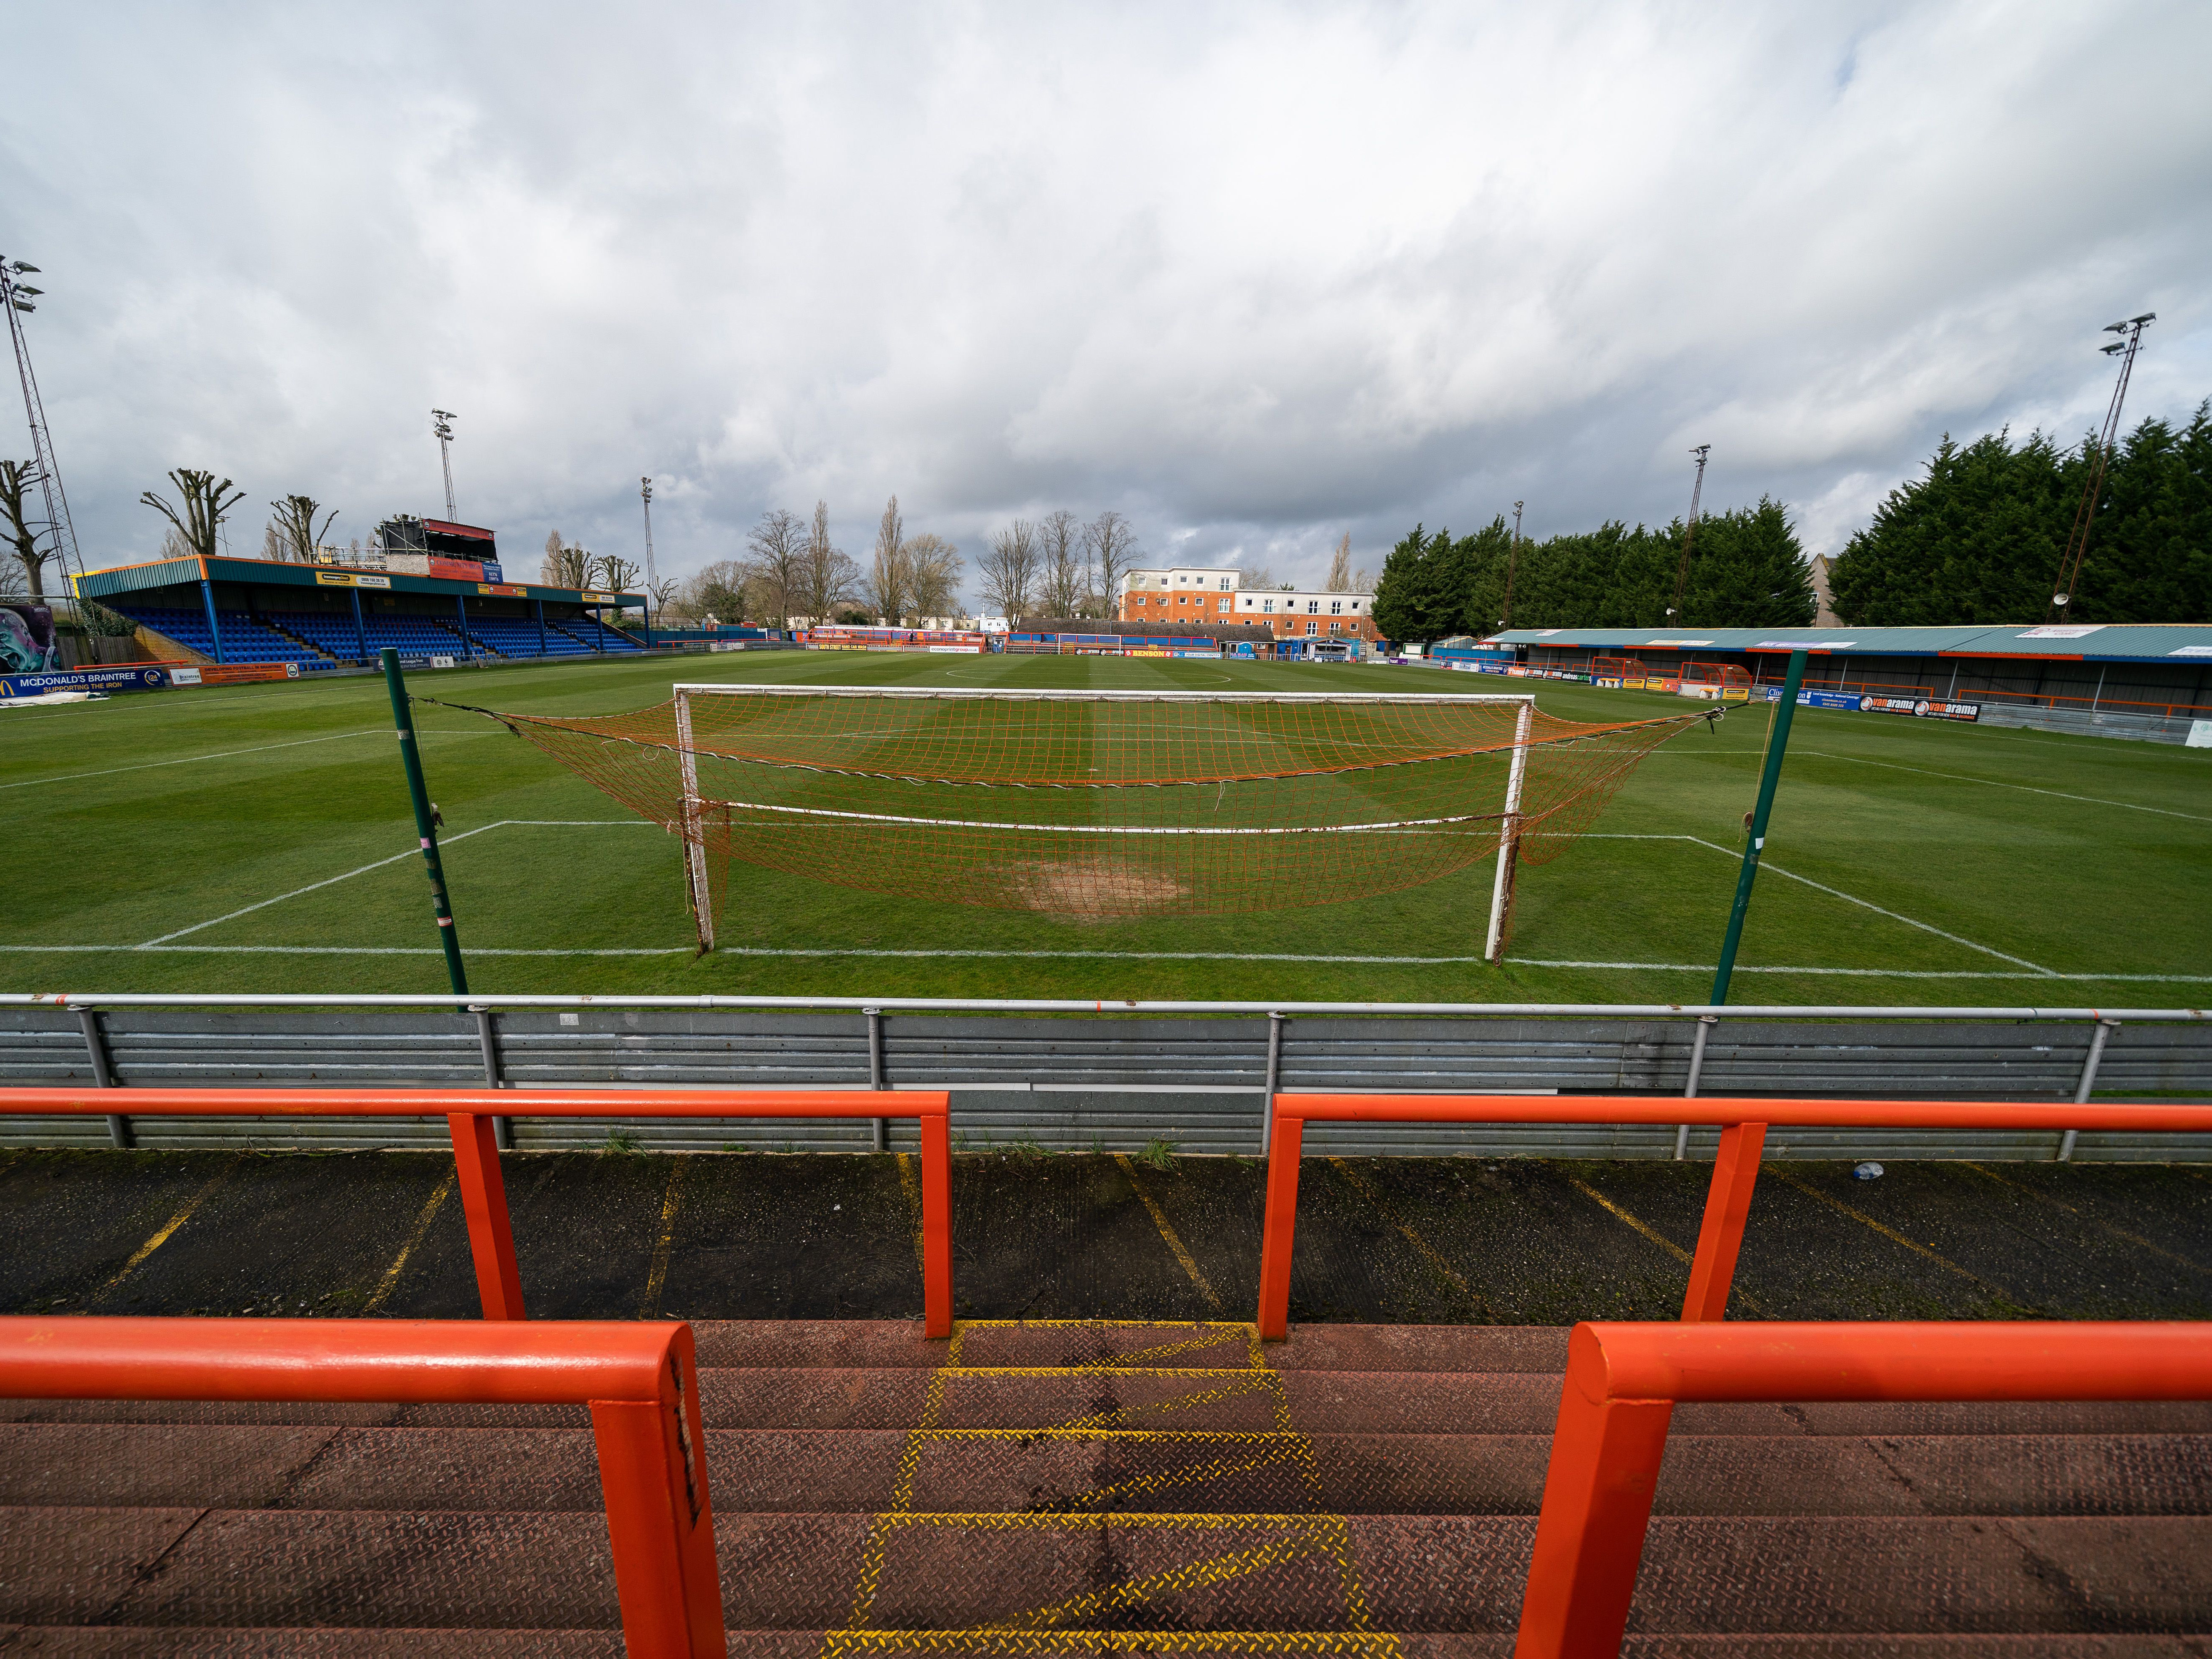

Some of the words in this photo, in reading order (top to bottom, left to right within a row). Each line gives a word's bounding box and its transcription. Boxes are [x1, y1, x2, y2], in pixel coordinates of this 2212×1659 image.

[20, 675, 85, 687] MCDONALD'S
[88, 672, 136, 682] BRAINTREE
[43, 684, 89, 693] SUPPORTING
[1873, 698, 1914, 709] vanarama
[1929, 703, 1978, 715] vanarama
